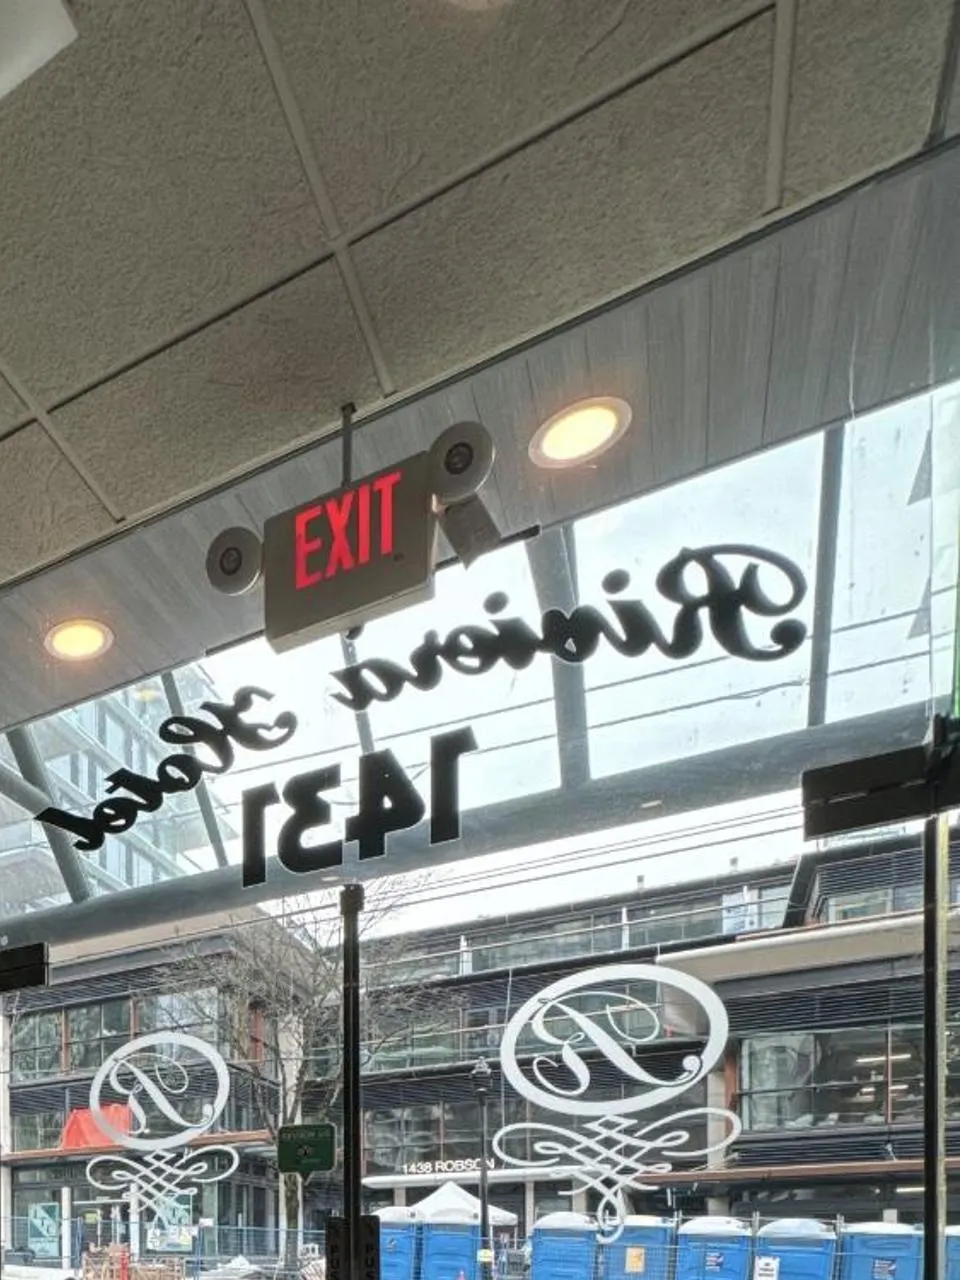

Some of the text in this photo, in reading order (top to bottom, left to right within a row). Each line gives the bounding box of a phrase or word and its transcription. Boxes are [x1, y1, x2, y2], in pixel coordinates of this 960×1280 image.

[295, 471, 402, 590] EXIT
[402, 1157, 496, 1176] 1438 ROBSON
